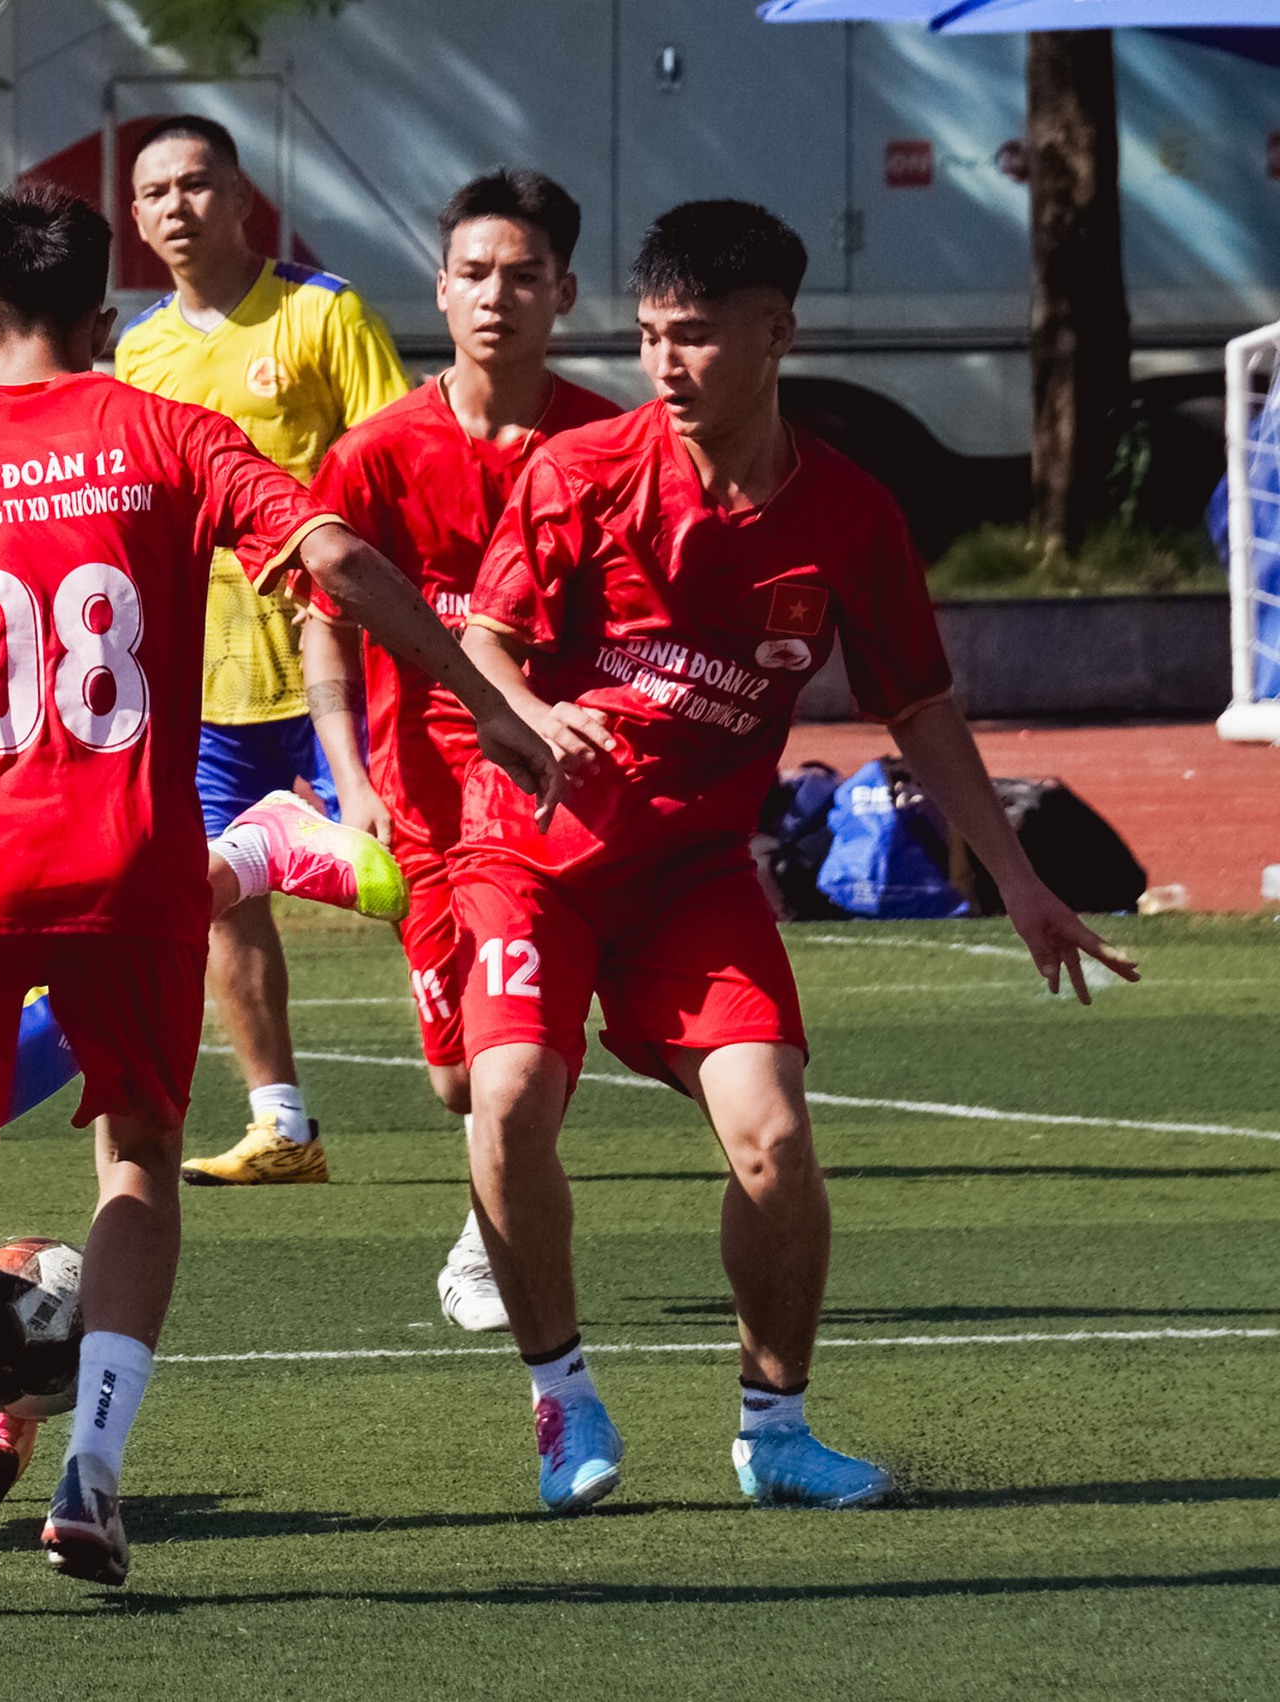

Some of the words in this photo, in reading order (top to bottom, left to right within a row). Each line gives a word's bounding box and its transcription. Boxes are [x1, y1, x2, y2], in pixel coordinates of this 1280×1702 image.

[1, 451, 85, 490] ĐOÀN
[95, 448, 126, 476] 12
[3, 498, 25, 524] TY
[23, 496, 50, 522] XD
[50, 482, 119, 520] TRƯỜNG
[121, 483, 153, 512] SƠN
[435, 592, 471, 617] BIN
[625, 640, 689, 675] BINH
[687, 651, 750, 694] ĐOÀN
[740, 677, 770, 701] 12
[479, 938, 542, 998] 12
